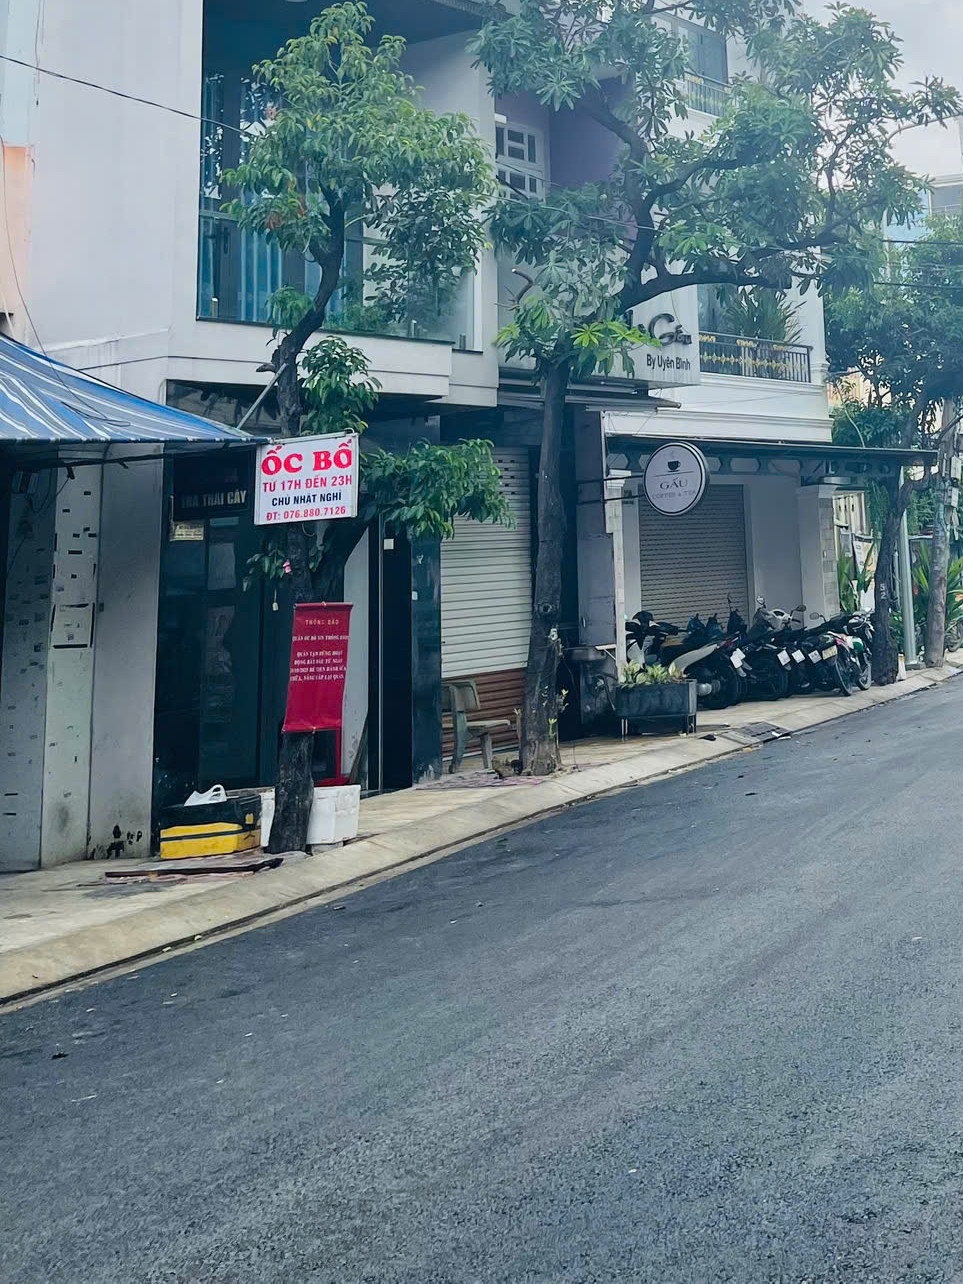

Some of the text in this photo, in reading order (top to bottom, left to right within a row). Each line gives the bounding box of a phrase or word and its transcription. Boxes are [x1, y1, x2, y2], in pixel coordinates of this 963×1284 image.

[647, 354, 656, 369] By
[262, 445, 303, 475] ỐC
[281, 479, 302, 491] 17H
[305, 474, 327, 489] ĐẾN
[331, 475, 352, 487] 23H
[659, 476, 688, 490] GẤU
[227, 489, 247, 504] CÂY
[272, 490, 342, 507] CHỦ NHẬT NGHỈ
[266, 506, 346, 521] ĐT: 076.880.7126
